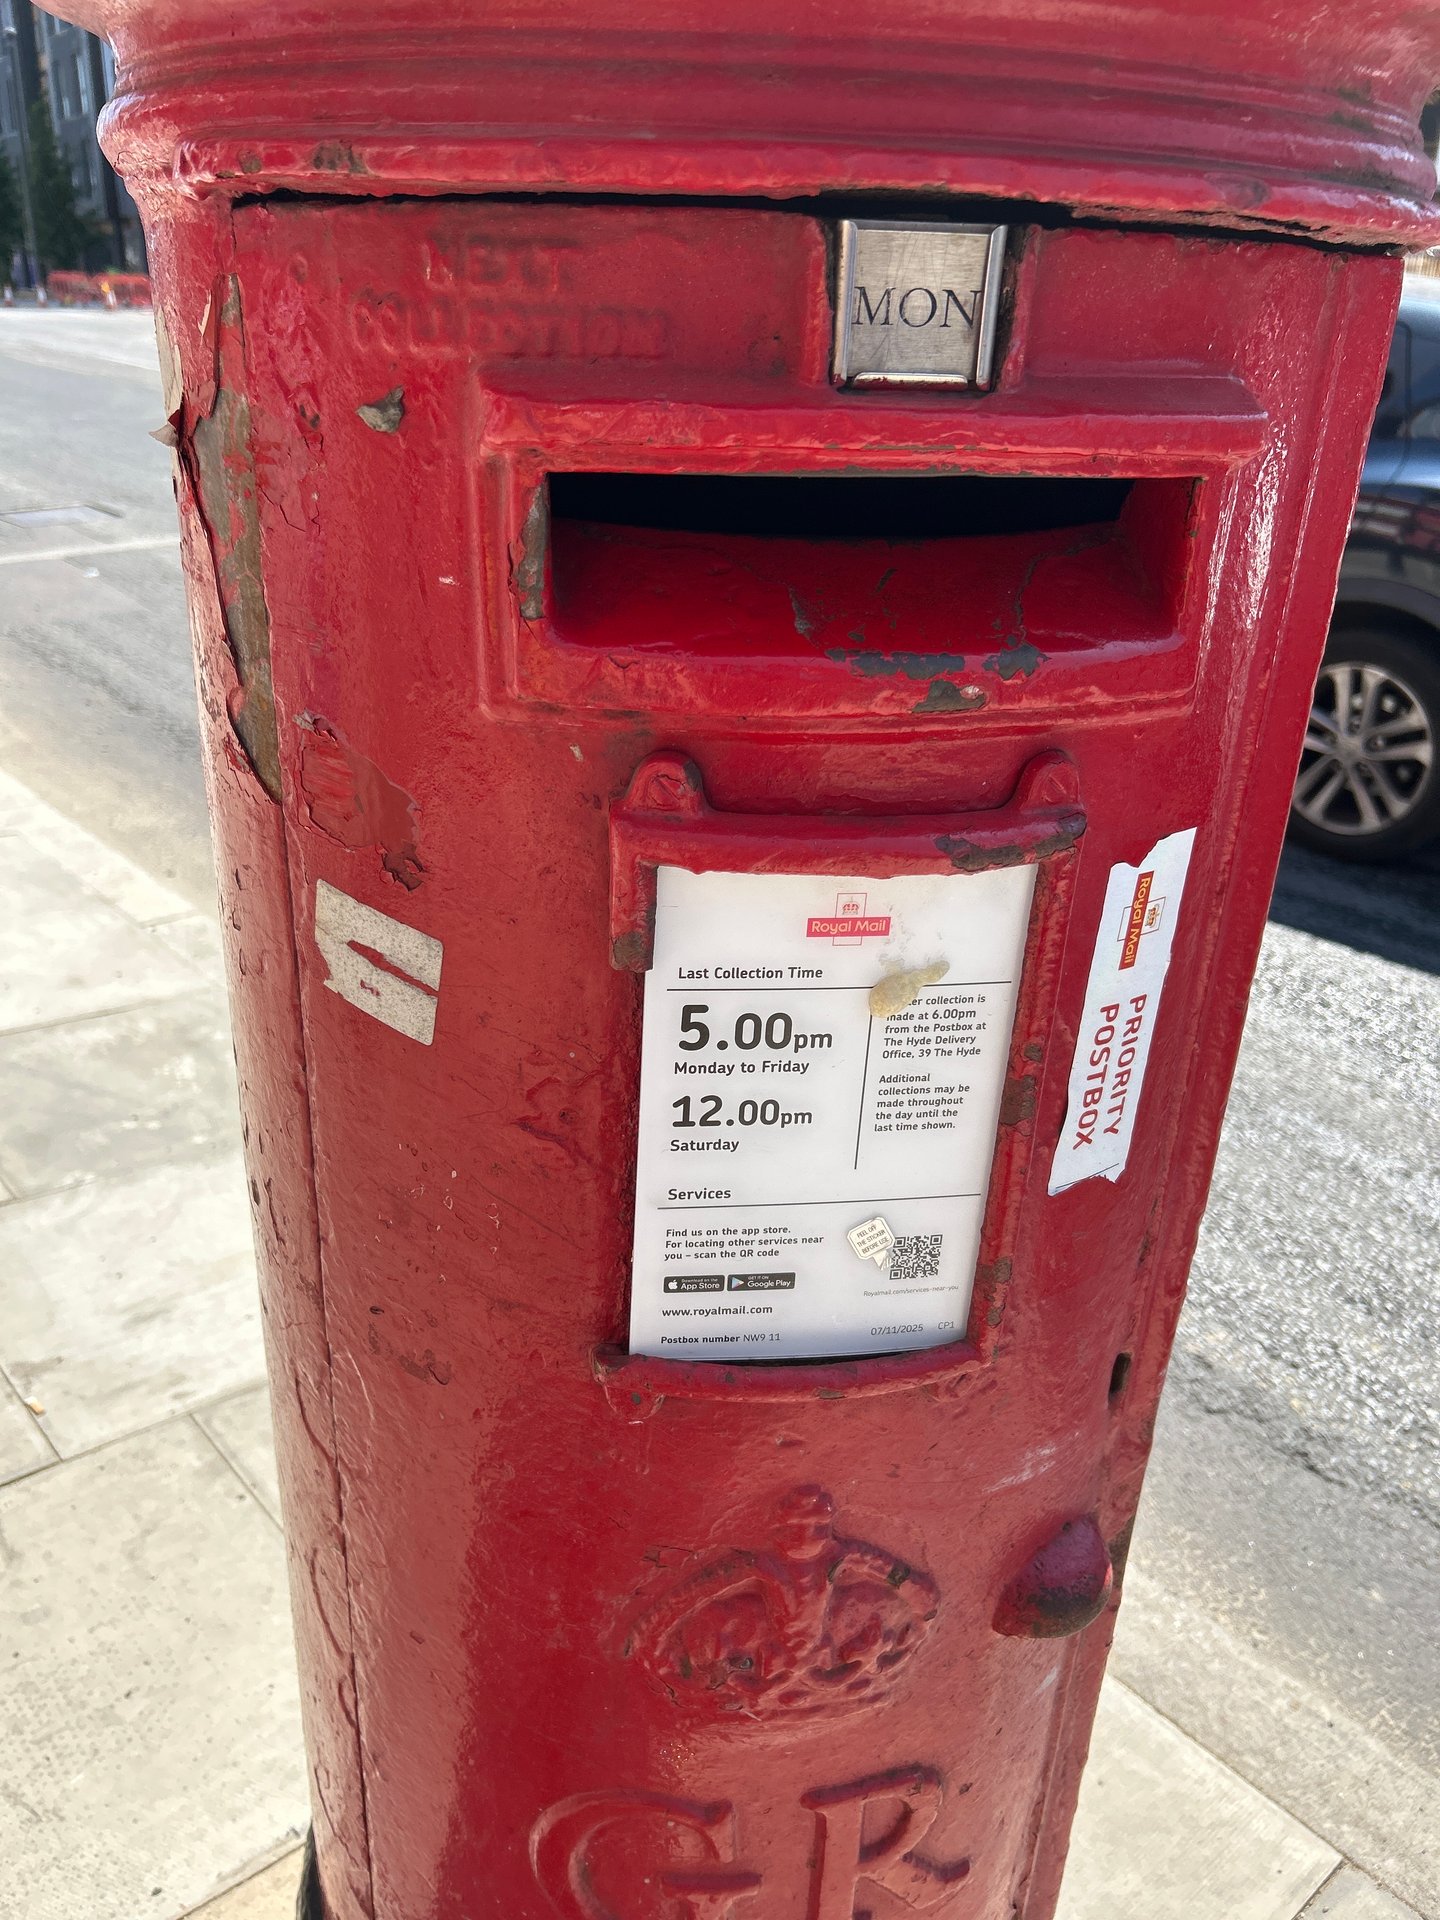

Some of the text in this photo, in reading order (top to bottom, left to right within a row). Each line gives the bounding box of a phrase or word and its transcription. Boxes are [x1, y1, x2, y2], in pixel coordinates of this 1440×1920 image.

[851, 286, 982, 329] MON
[1124, 877, 1151, 964] Royal Mail
[811, 920, 886, 935] Royal Mail
[678, 966, 823, 979] Last Collection Time
[925, 994, 974, 1006] collection
[977, 993, 986, 1003] is
[886, 1008, 976, 1021] made at 6.00pm
[678, 1004, 833, 1054] 5.00pm
[885, 1022, 987, 1034] from the Postbox at
[884, 1034, 977, 1047] The Hyde Delivery
[882, 1046, 981, 1059] Office, 39 The Hyde
[674, 1060, 810, 1076] Monday to Friday
[1103, 993, 1147, 1135] PRIORITY
[879, 1073, 931, 1083] Additional
[1073, 1003, 1120, 1150] POSTBOX
[878, 1084, 970, 1096] collections may be
[877, 1096, 964, 1108] made throughout
[672, 1094, 813, 1129] 12.00pm
[875, 1108, 958, 1120] the day until the
[874, 1121, 956, 1132] last time shown.
[670, 1138, 740, 1153] Saturday
[668, 1187, 731, 1200] Services
[666, 1228, 688, 1237] Find
[691, 1229, 703, 1237] us
[721, 1227, 738, 1236] the
[741, 1227, 760, 1236] app
[763, 1226, 791, 1234] store.
[665, 1235, 824, 1249] For locating other services near
[664, 1252, 683, 1262] you
[694, 1251, 717, 1259] scan
[720, 1249, 736, 1258] the
[739, 1249, 754, 1258] QR
[757, 1248, 780, 1257] code
[747, 1279, 791, 1288] Google Play
[662, 1305, 773, 1317] www.royalmail.com
[870, 1321, 955, 1336] 07/11/2025 CP1
[661, 1333, 781, 1344] Postbox number NW9 11
